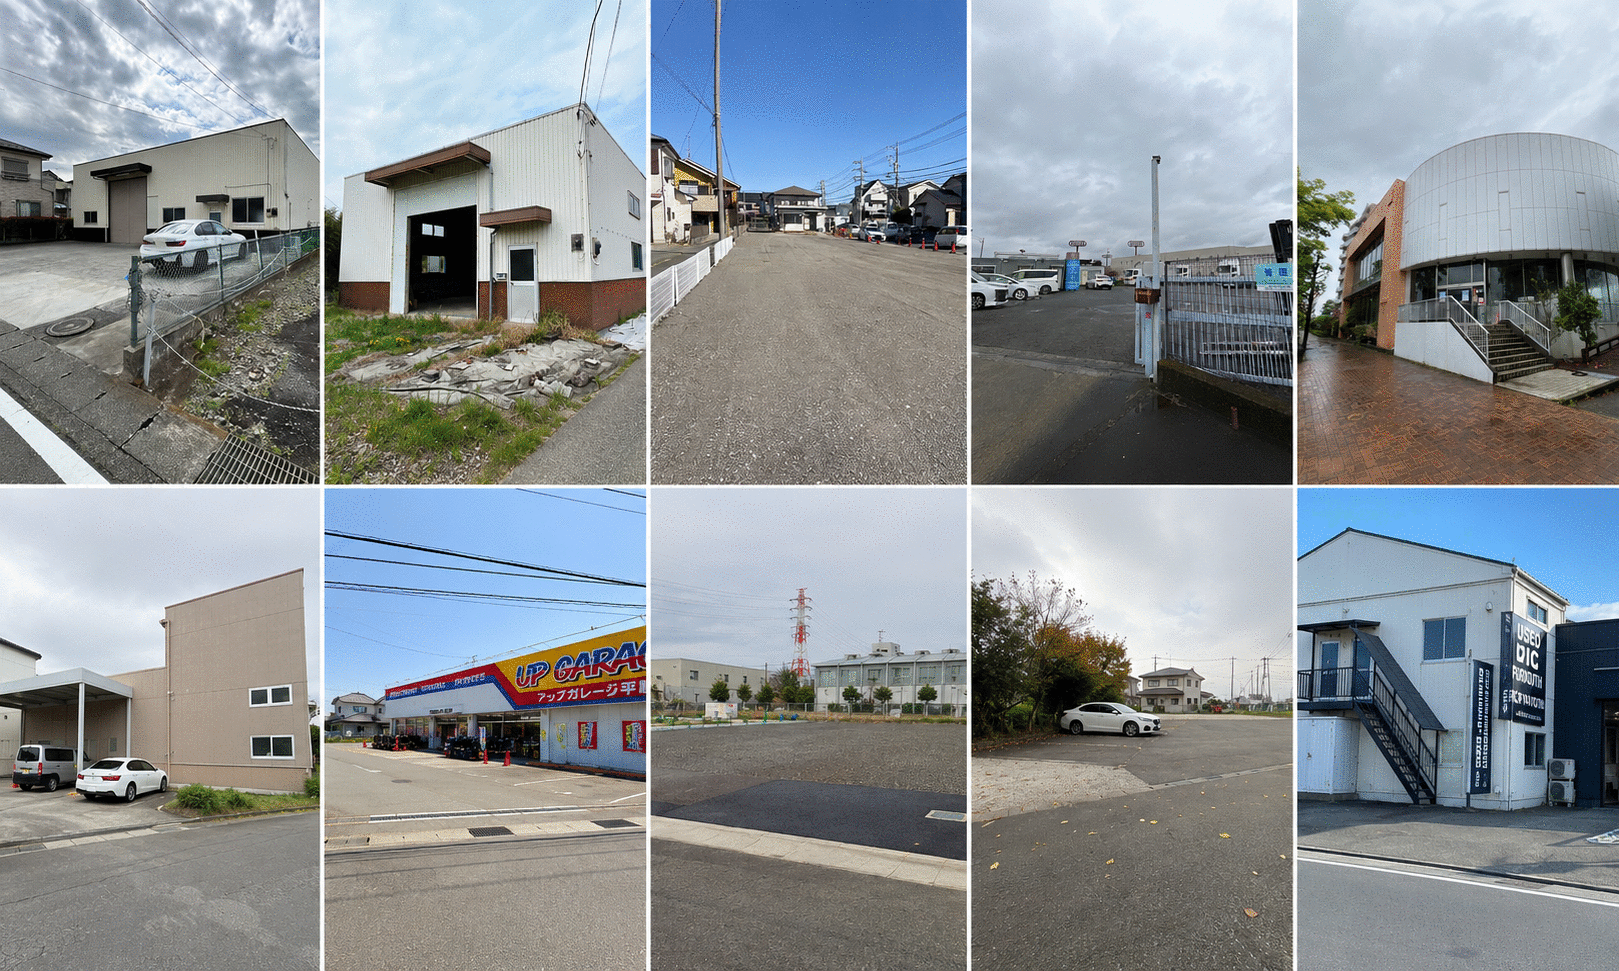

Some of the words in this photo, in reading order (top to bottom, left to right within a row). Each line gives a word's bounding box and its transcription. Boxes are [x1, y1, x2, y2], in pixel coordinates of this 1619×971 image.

[1517, 622, 1541, 649] USED
[1516, 642, 1539, 670] DIC
[515, 661, 550, 688] UP
